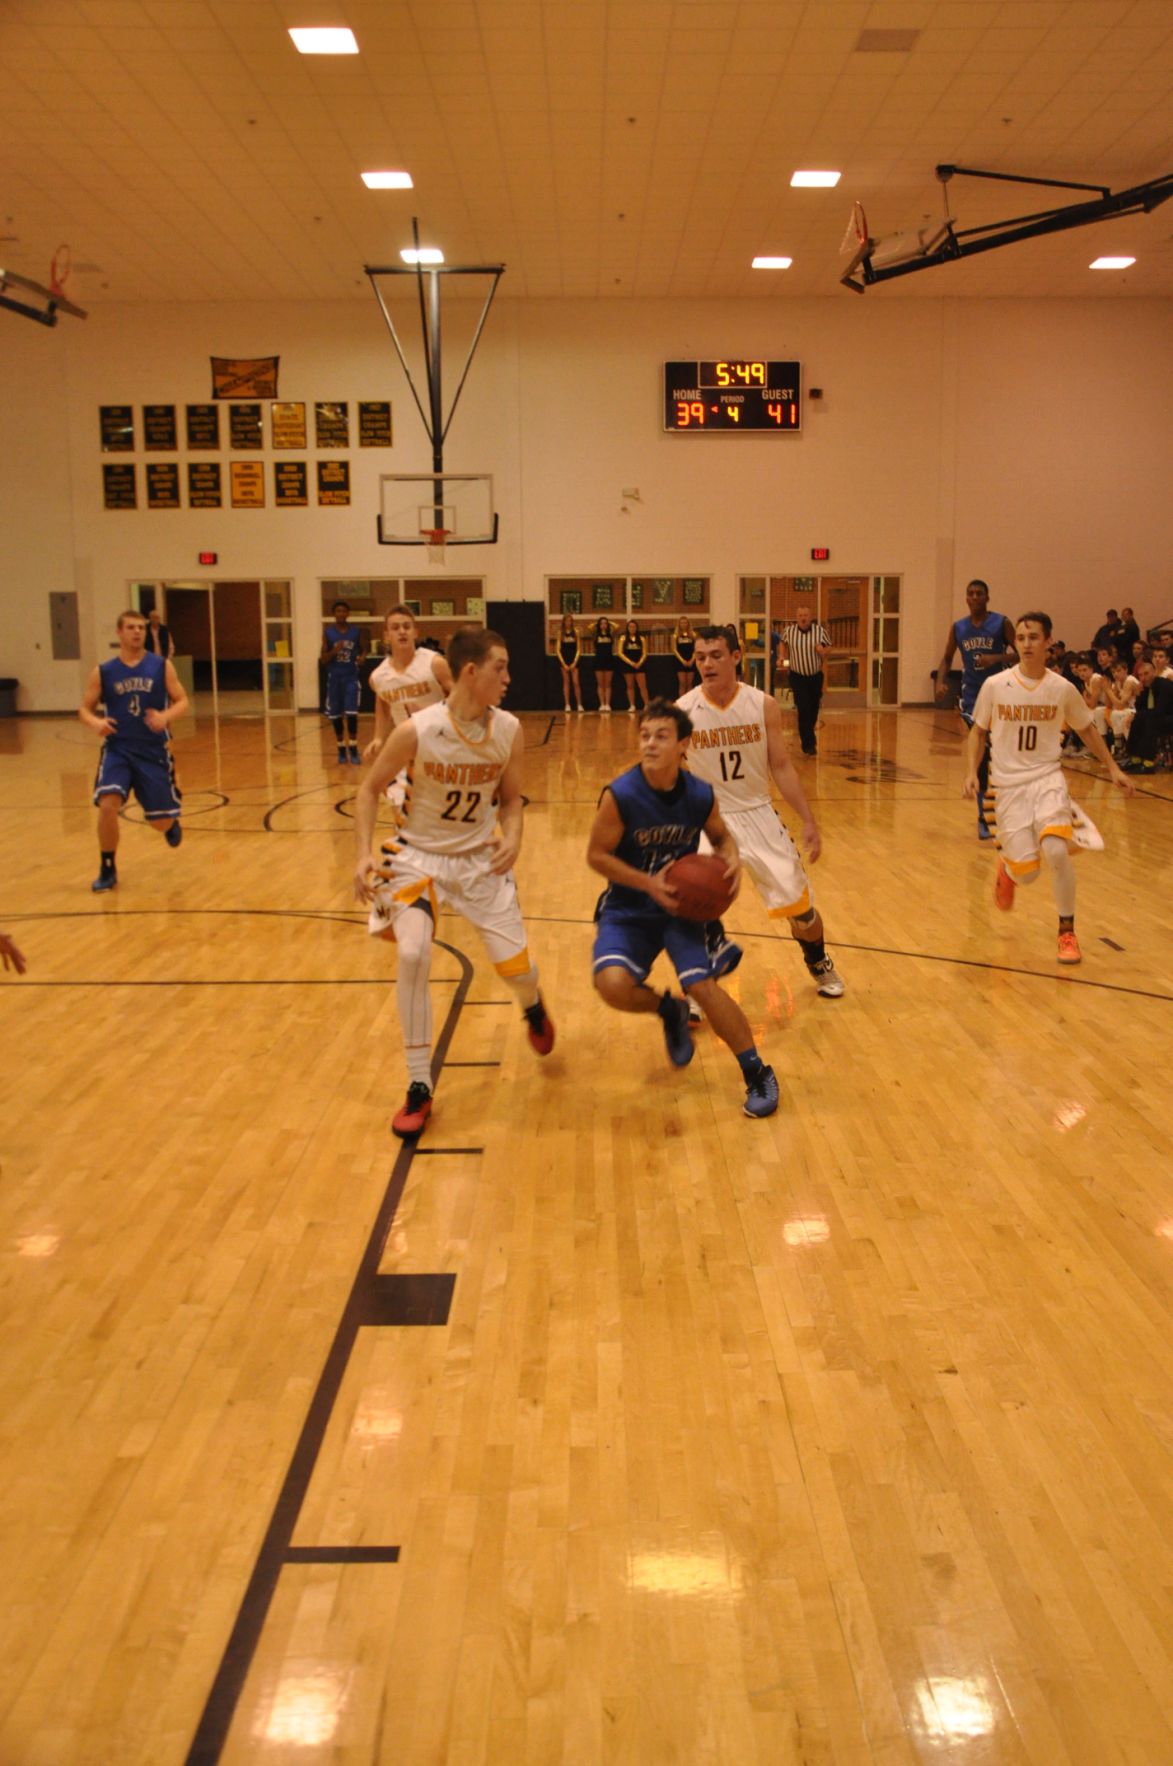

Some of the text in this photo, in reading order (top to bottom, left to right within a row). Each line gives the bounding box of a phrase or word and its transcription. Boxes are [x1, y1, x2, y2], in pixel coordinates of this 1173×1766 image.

[716, 363, 764, 386] 5:49
[673, 389, 702, 400] HOME
[720, 395, 745, 403] PERIOD
[762, 389, 794, 400] GUEST
[677, 403, 704, 426] 39
[727, 406, 739, 422] 4
[767, 404, 796, 424] 41
[128, 694, 141, 717] 4
[692, 723, 762, 749] PANTHERS
[1018, 725, 1037, 752] 10
[720, 751, 745, 781] 12
[440, 790, 482, 823] 22
